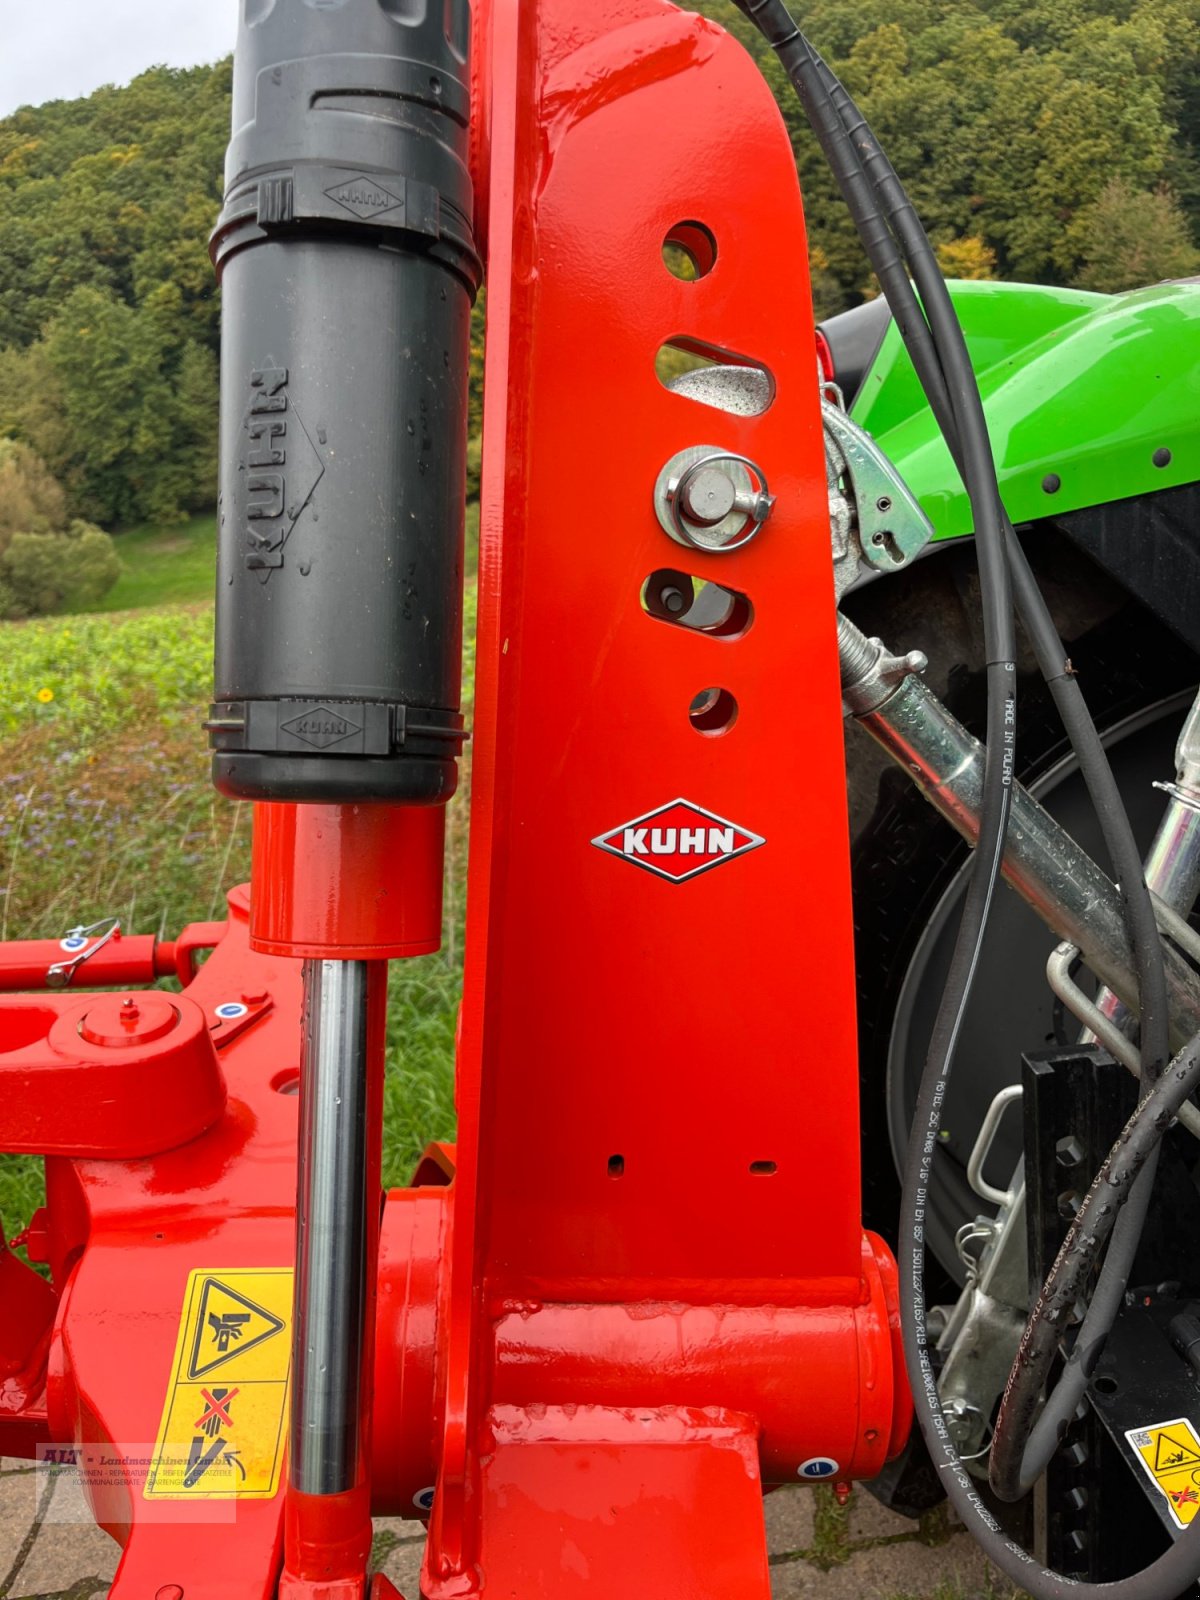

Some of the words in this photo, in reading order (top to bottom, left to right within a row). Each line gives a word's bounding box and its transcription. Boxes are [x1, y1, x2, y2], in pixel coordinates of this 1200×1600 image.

[246, 367, 289, 569] KUHN
[1004, 699, 1014, 725] MADE
[296, 720, 348, 735] KUHN
[1004, 731, 1014, 743] IN
[1002, 748, 1013, 785] POLAND
[623, 828, 734, 854] KUHN
[933, 1081, 946, 1107] ASTEC
[916, 1188, 927, 1205] DIN
[914, 1209, 925, 1222] EN
[913, 1225, 923, 1243] 857
